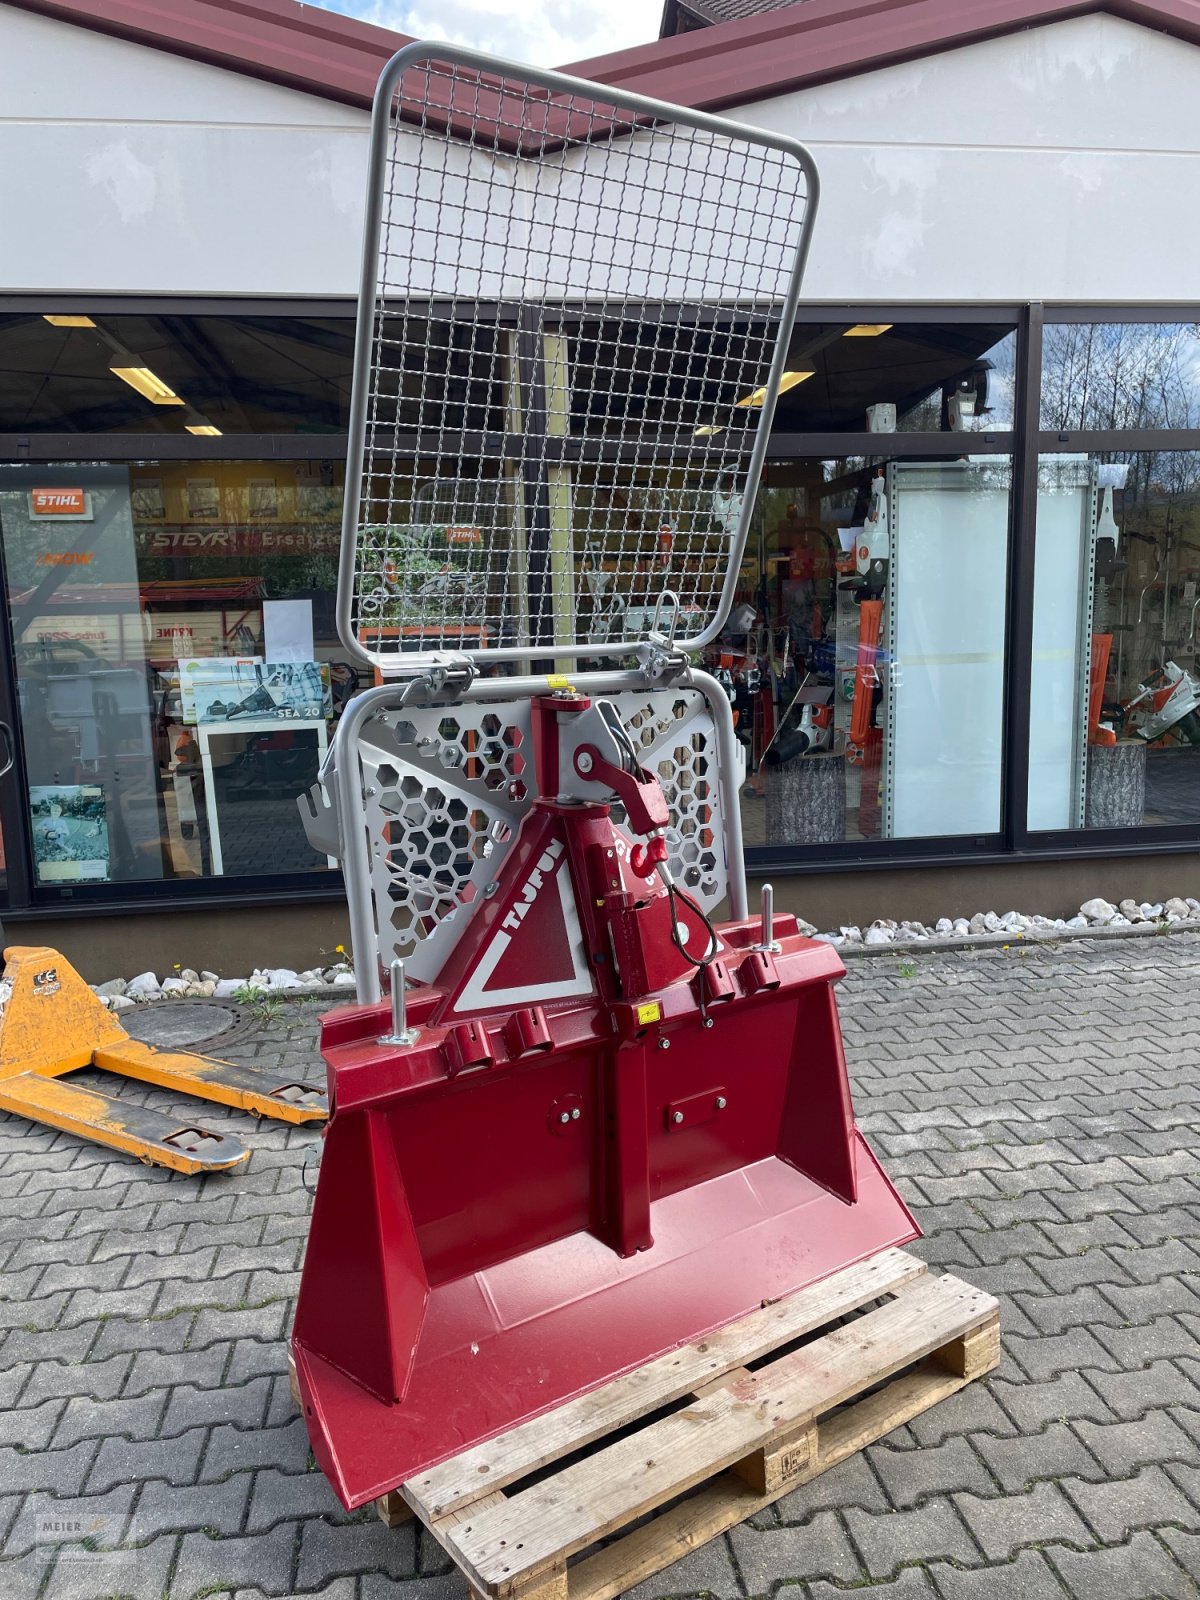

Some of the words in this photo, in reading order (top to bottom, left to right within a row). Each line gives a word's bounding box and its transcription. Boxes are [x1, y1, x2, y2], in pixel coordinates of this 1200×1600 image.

[37, 495, 80, 506] STIHL
[153, 532, 230, 546] STEYR
[277, 709, 301, 719] SEA
[303, 707, 321, 717] 20
[501, 837, 565, 929] TAJFUN
